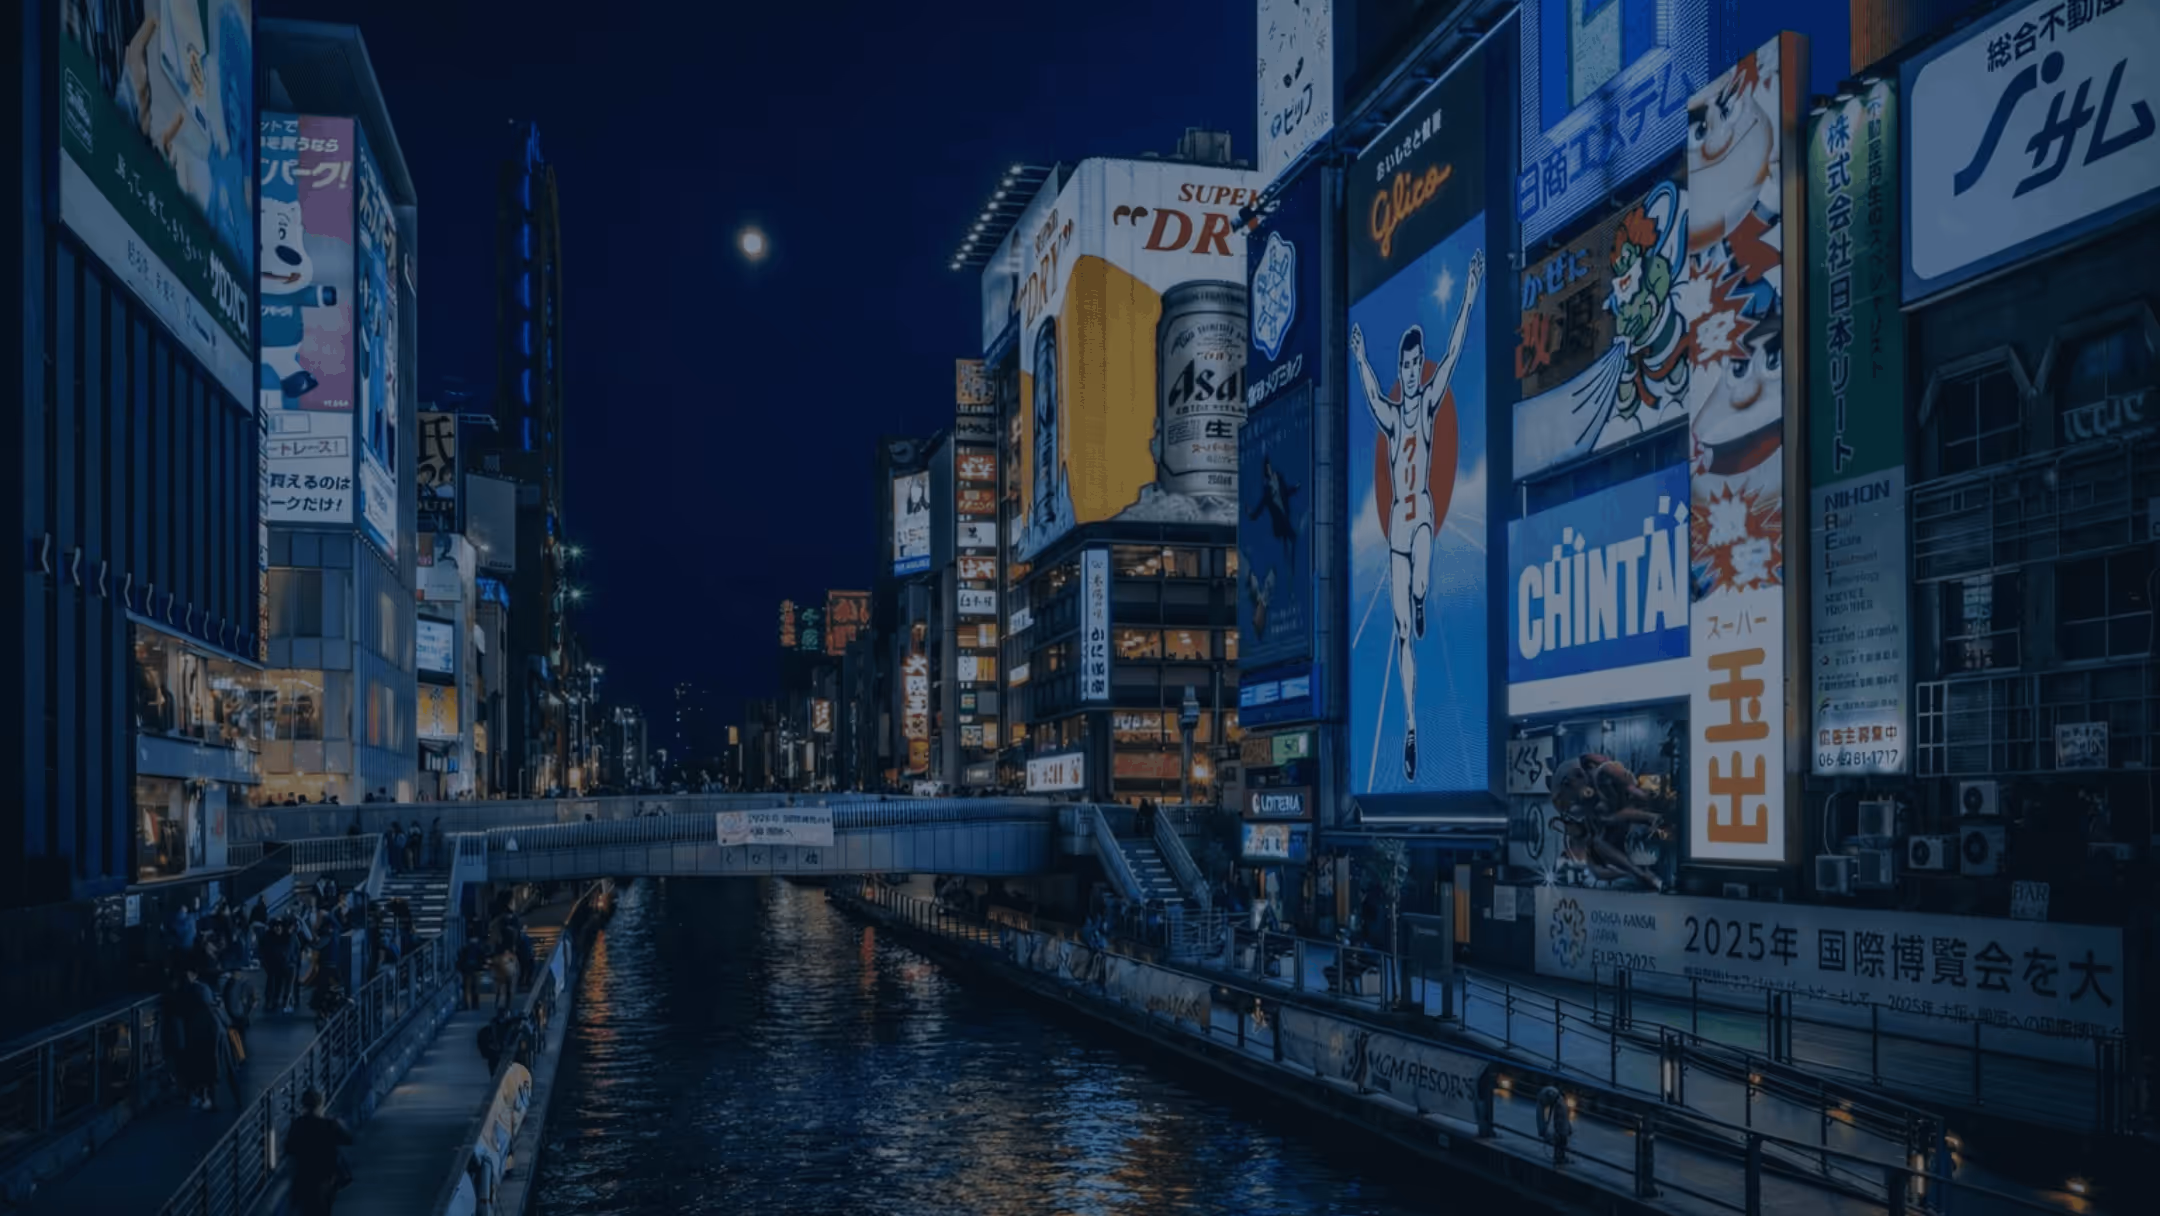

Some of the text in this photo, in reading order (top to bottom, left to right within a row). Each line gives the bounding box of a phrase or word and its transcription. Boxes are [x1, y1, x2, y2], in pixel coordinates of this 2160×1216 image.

[1370, 163, 1454, 260] Glico
[1826, 113, 1855, 474] 株式会社日本リート
[1205, 418, 1233, 438] 生
[270, 473, 351, 491] 買えるのは
[1403, 430, 1417, 522] グリコ
[1824, 480, 1890, 513] NIHON
[1518, 520, 1689, 660] CHINTAI
[1707, 610, 1768, 641] スーパー
[1704, 647, 1770, 844] 玉出
[1685, 916, 1798, 965] 2025年
[1818, 928, 2113, 1007] 国際博覧会を大
